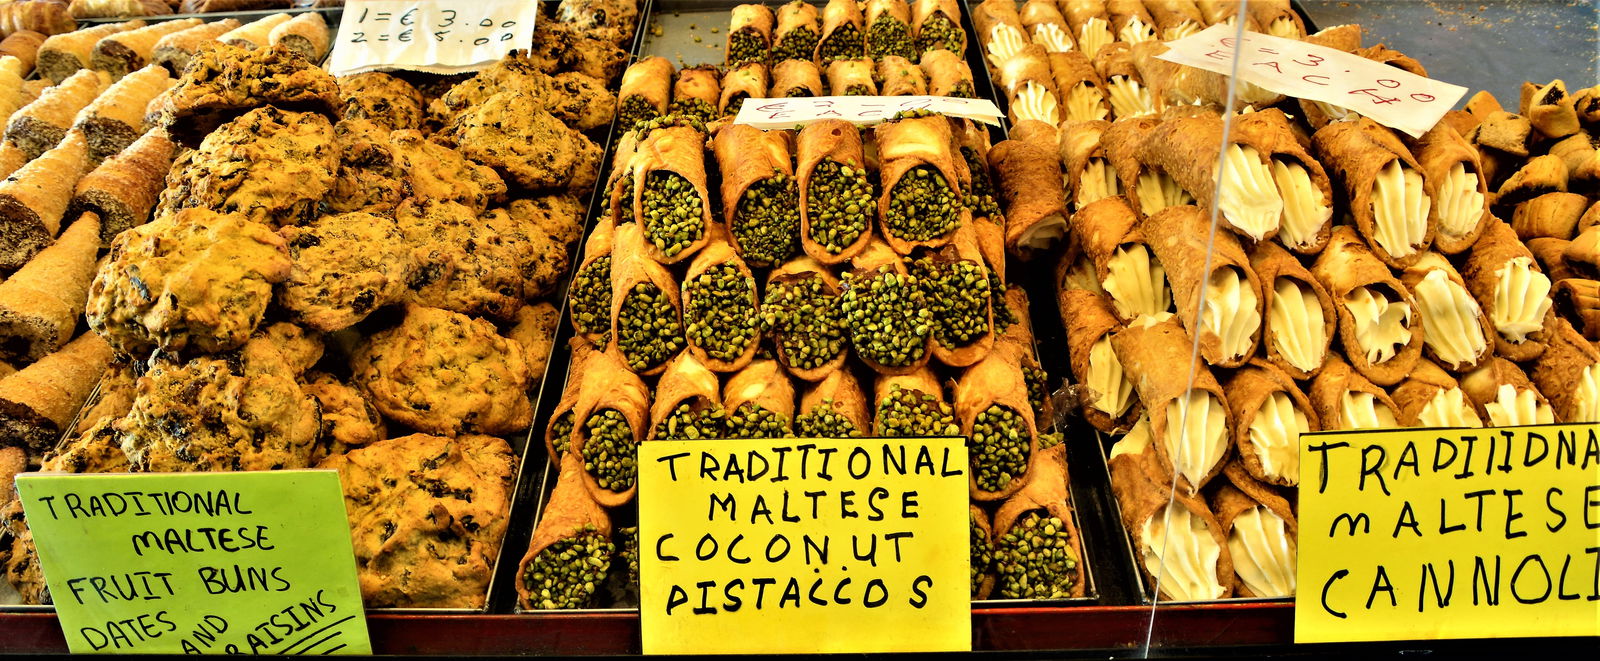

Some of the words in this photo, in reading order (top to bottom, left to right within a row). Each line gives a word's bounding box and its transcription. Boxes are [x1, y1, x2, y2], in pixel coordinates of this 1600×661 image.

[657, 442, 963, 483] TRADITIONAL
[38, 489, 253, 520] TRADITIONAL
[708, 487, 919, 525] MALTESE
[131, 525, 275, 557] MALTESE
[656, 531, 914, 567] COCONUT
[67, 570, 175, 605] FRUIT
[198, 564, 291, 595] BUNS
[1321, 547, 1600, 619] CANNOLI
[80, 610, 177, 652] DATES
[180, 614, 229, 655] AND
